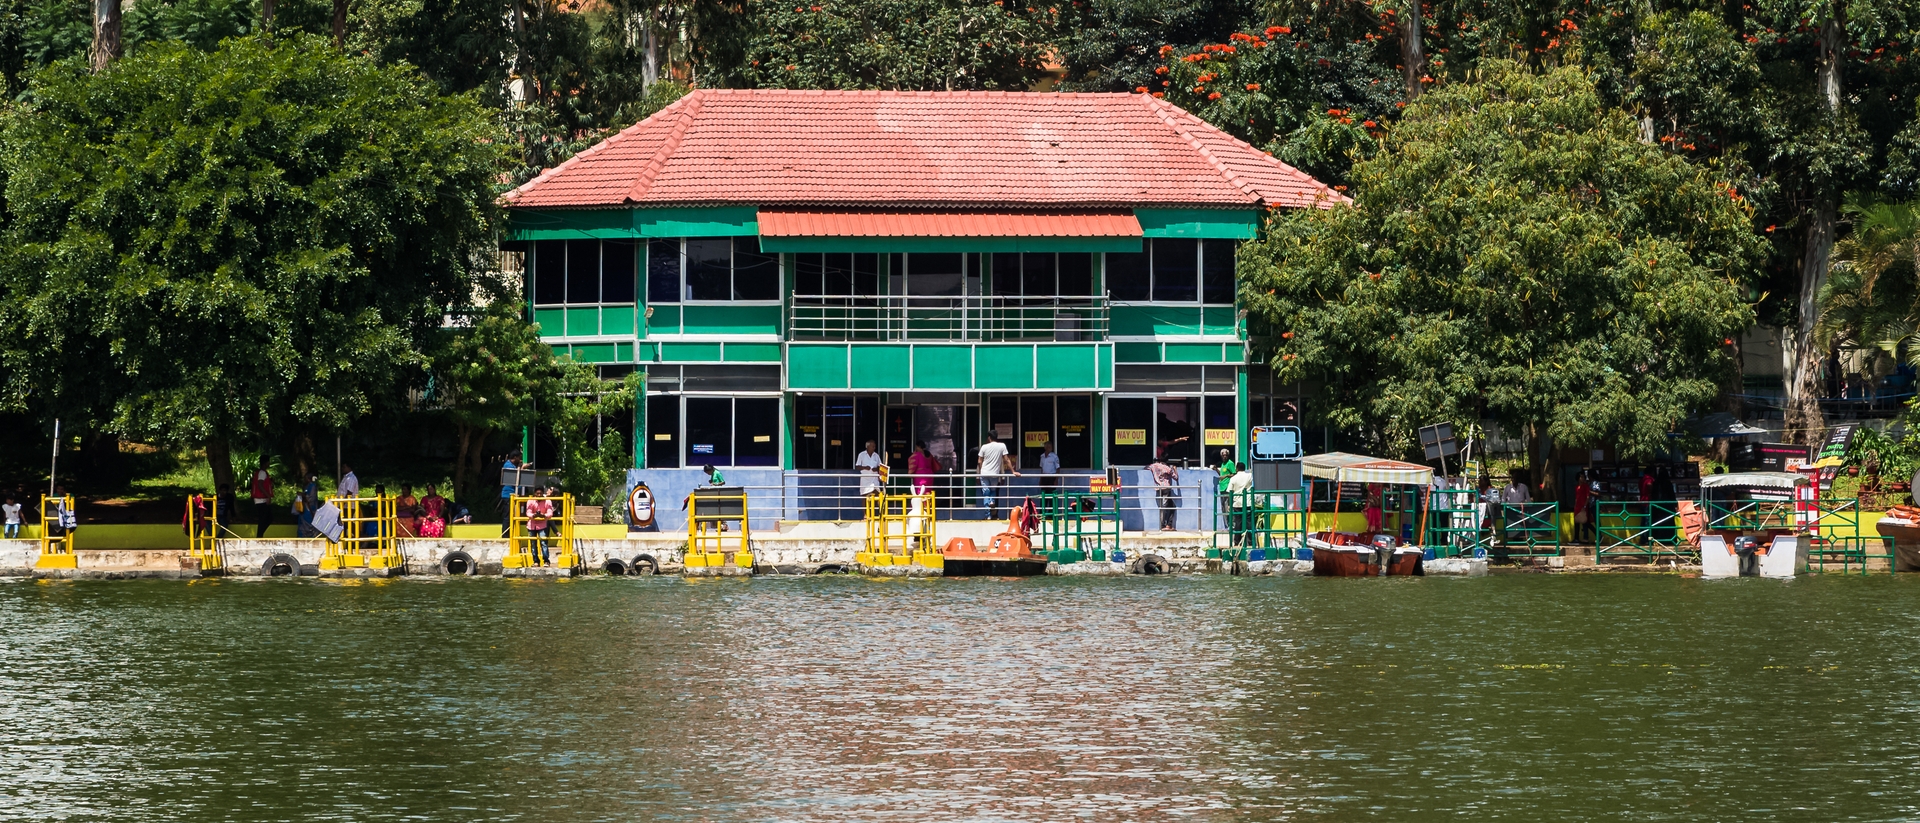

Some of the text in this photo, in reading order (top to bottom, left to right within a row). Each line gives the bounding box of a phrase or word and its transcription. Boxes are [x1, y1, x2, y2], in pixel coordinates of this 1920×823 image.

[1027, 433, 1048, 441] WAY OUT
[1117, 431, 1144, 439] WAY OUT
[1207, 431, 1234, 439] WAY OUT
